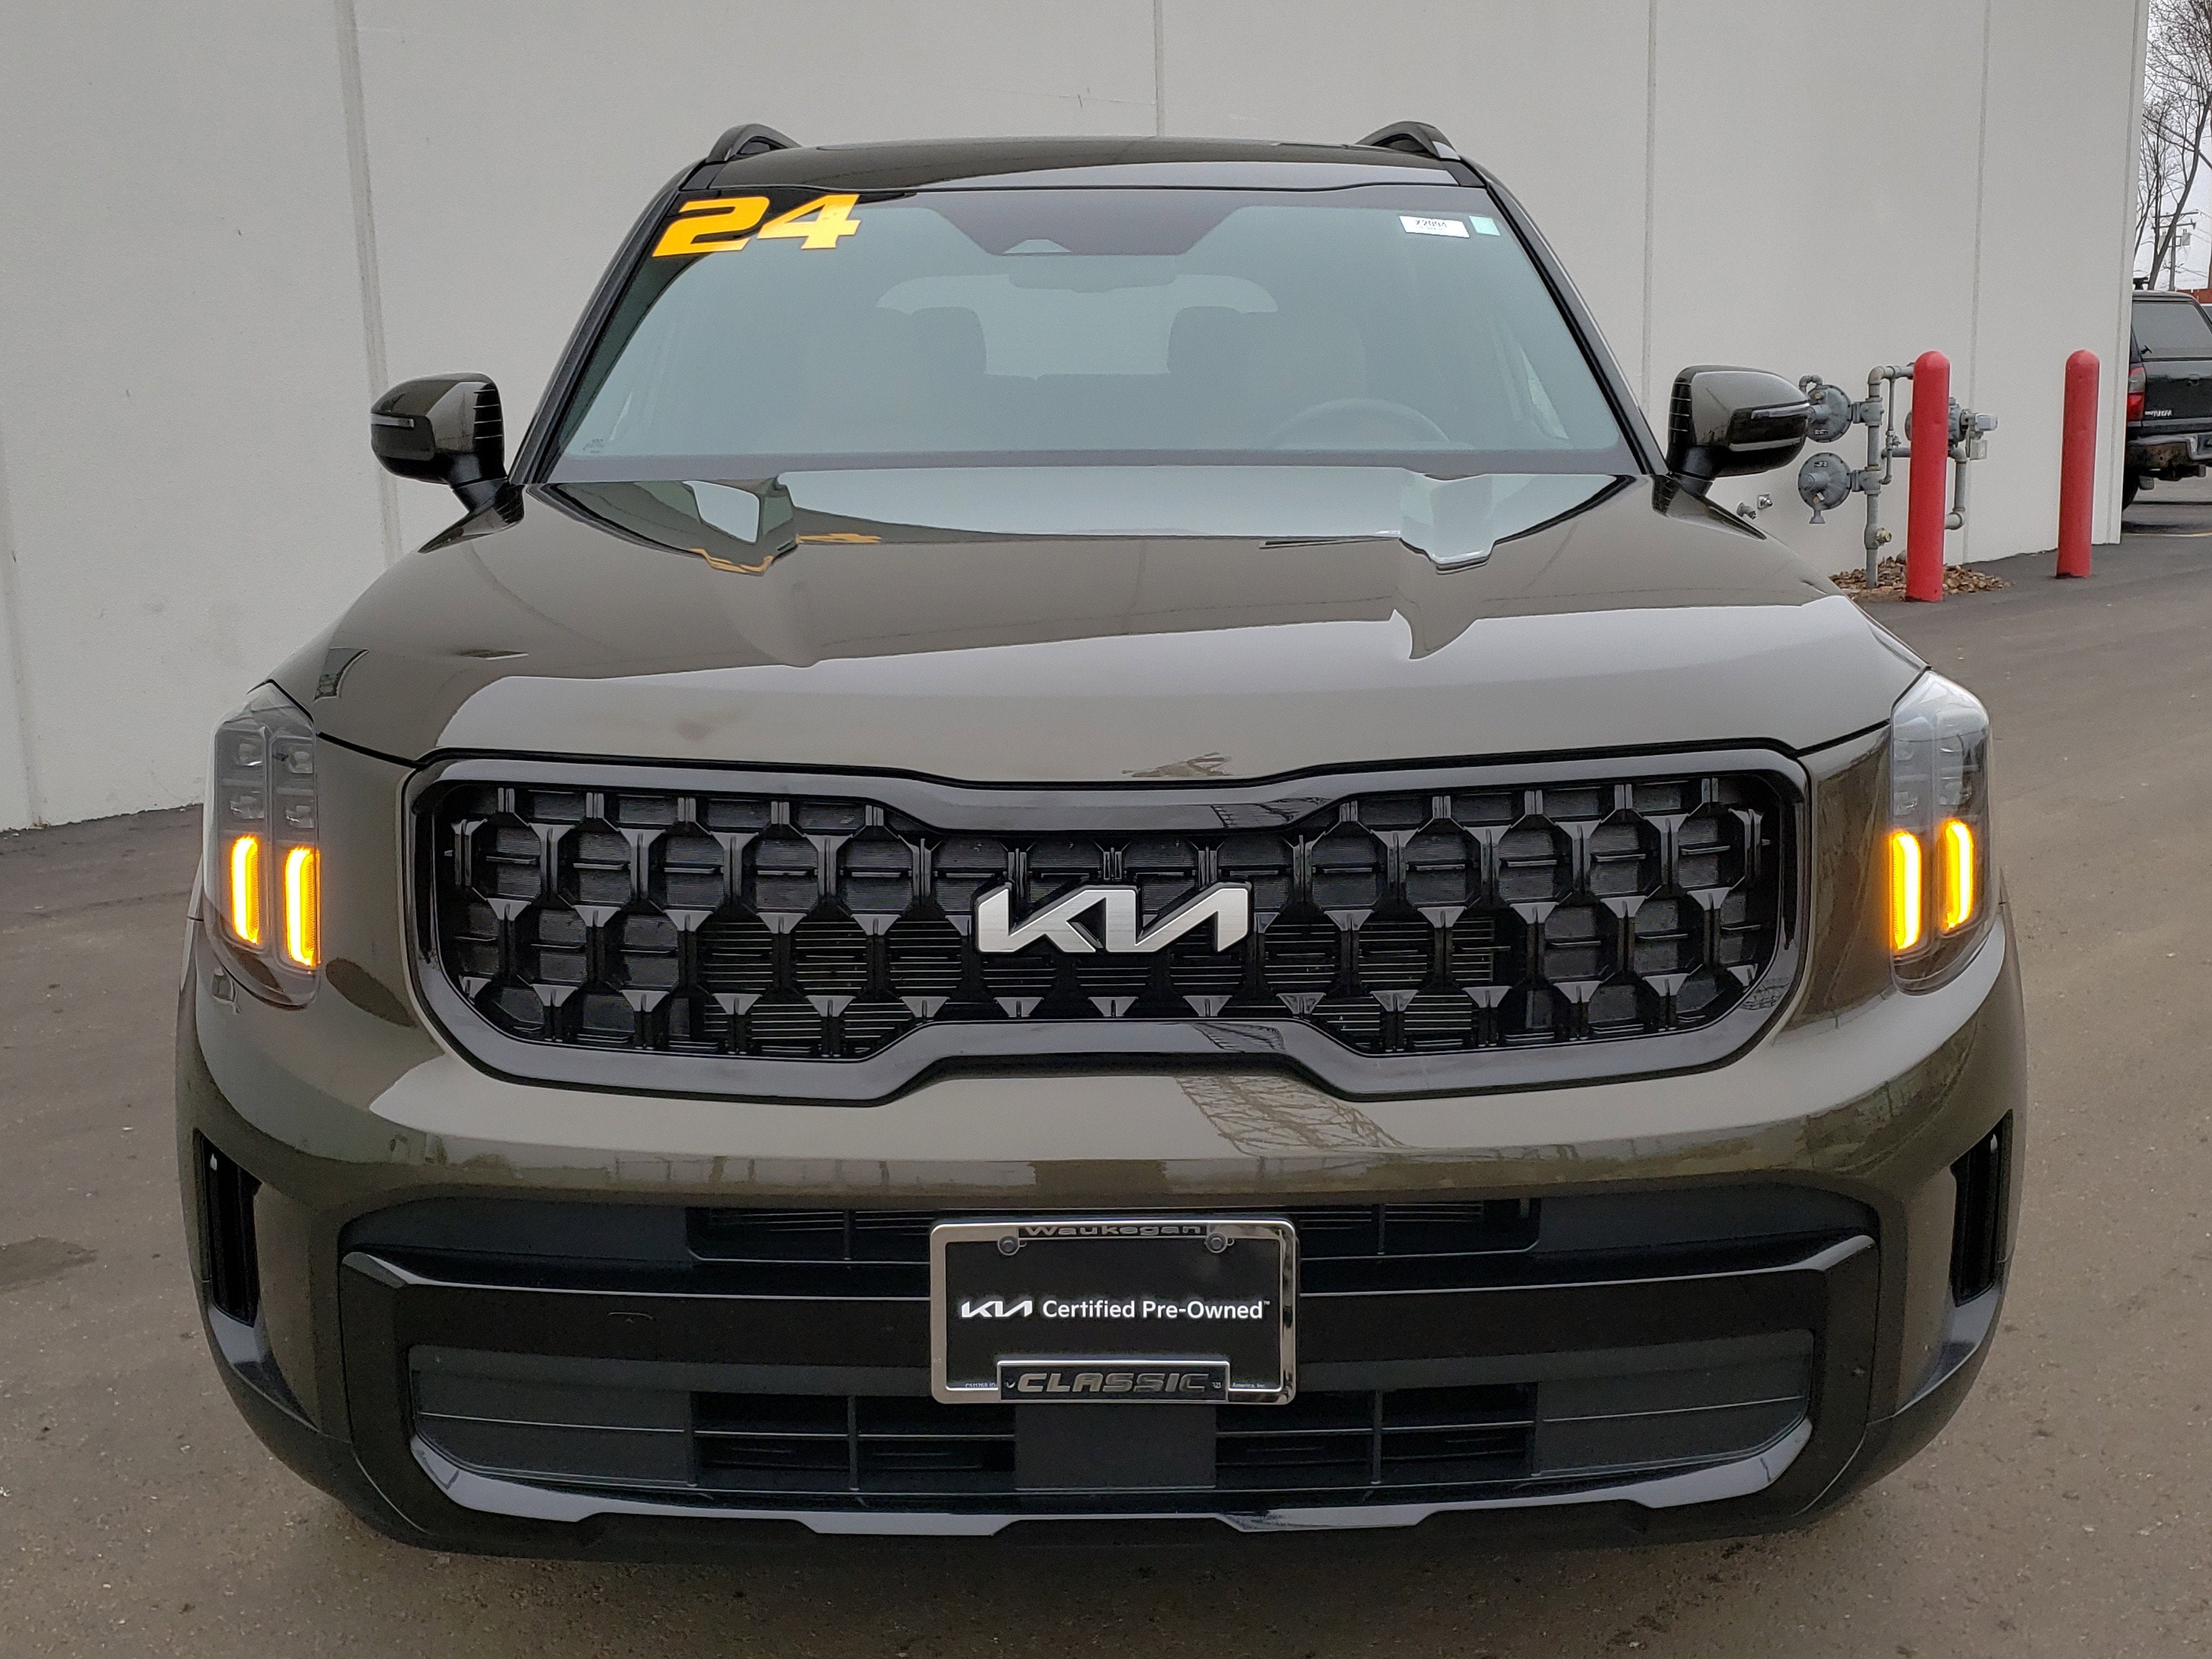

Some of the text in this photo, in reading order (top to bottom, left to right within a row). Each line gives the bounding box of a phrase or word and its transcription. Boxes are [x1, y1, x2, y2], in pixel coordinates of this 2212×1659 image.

[652, 194, 861, 257] 24
[1025, 1225, 1201, 1235] Waukegan
[1042, 1300, 1135, 1318] Certified
[1017, 1373, 1209, 1392] CLASSIC
